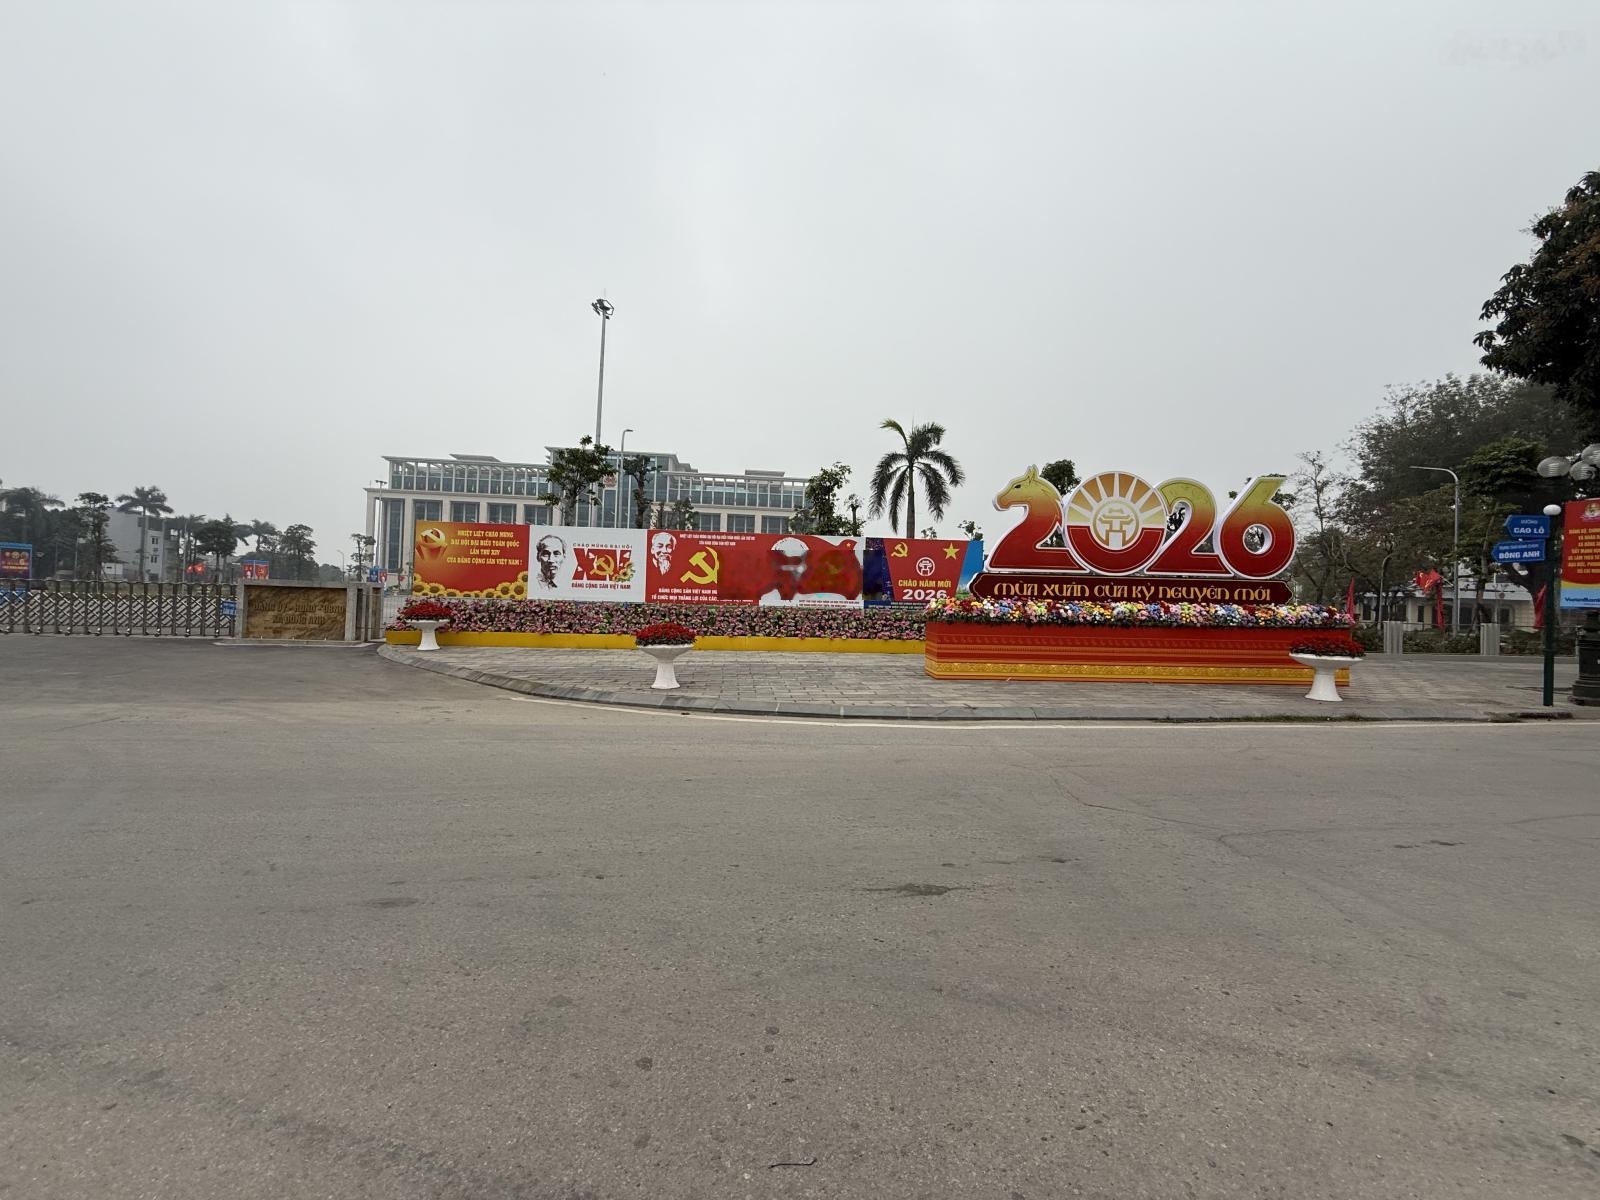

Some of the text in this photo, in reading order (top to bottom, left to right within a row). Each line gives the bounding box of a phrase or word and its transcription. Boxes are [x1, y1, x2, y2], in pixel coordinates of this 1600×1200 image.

[985, 466, 1297, 581] 2026
[898, 579, 952, 588] CHÀO NĂM MỚI
[994, 580, 1270, 602] MÙA XUÂN CỦA KỶ NGUYÊN MỚI
[902, 589, 948, 601] 2026
